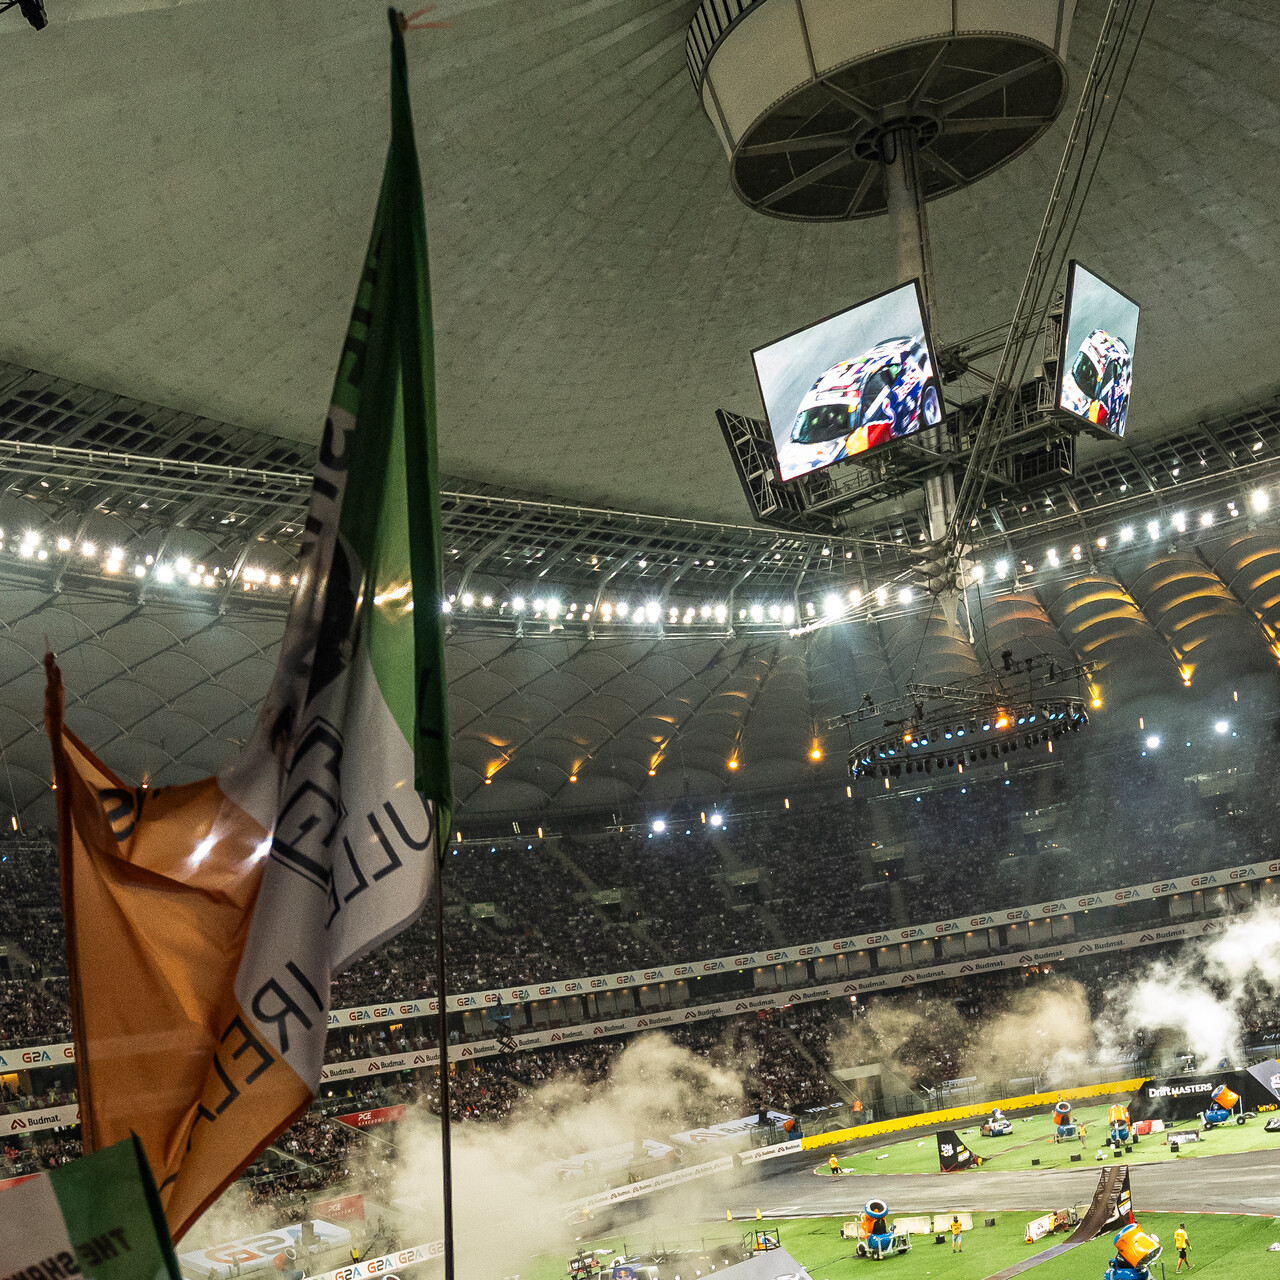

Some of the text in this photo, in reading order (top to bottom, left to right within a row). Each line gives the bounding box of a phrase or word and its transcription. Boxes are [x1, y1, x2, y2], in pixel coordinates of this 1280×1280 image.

[1191, 876, 1216, 886] G2A
[1115, 890, 1139, 900] G2A
[1042, 904, 1066, 913] G2A
[970, 917, 994, 926] G2A
[901, 929, 923, 938] G2A
[833, 941, 855, 950] G2A
[766, 952, 787, 961] G2A
[704, 962, 724, 971] G2A
[644, 971, 663, 980] G2A
[591, 979, 607, 988] G2A
[539, 987, 556, 995] G2A
[400, 1005, 419, 1014] G2A
[349, 1011, 370, 1021] G2A
[22, 1051, 50, 1063] G2A
[1148, 1082, 1212, 1098] Drift MASTERS
[28, 1115, 61, 1126] Budmat.
[359, 1112, 371, 1120] PGE
[398, 1249, 423, 1264] G2A
[367, 1258, 393, 1273] G2A
